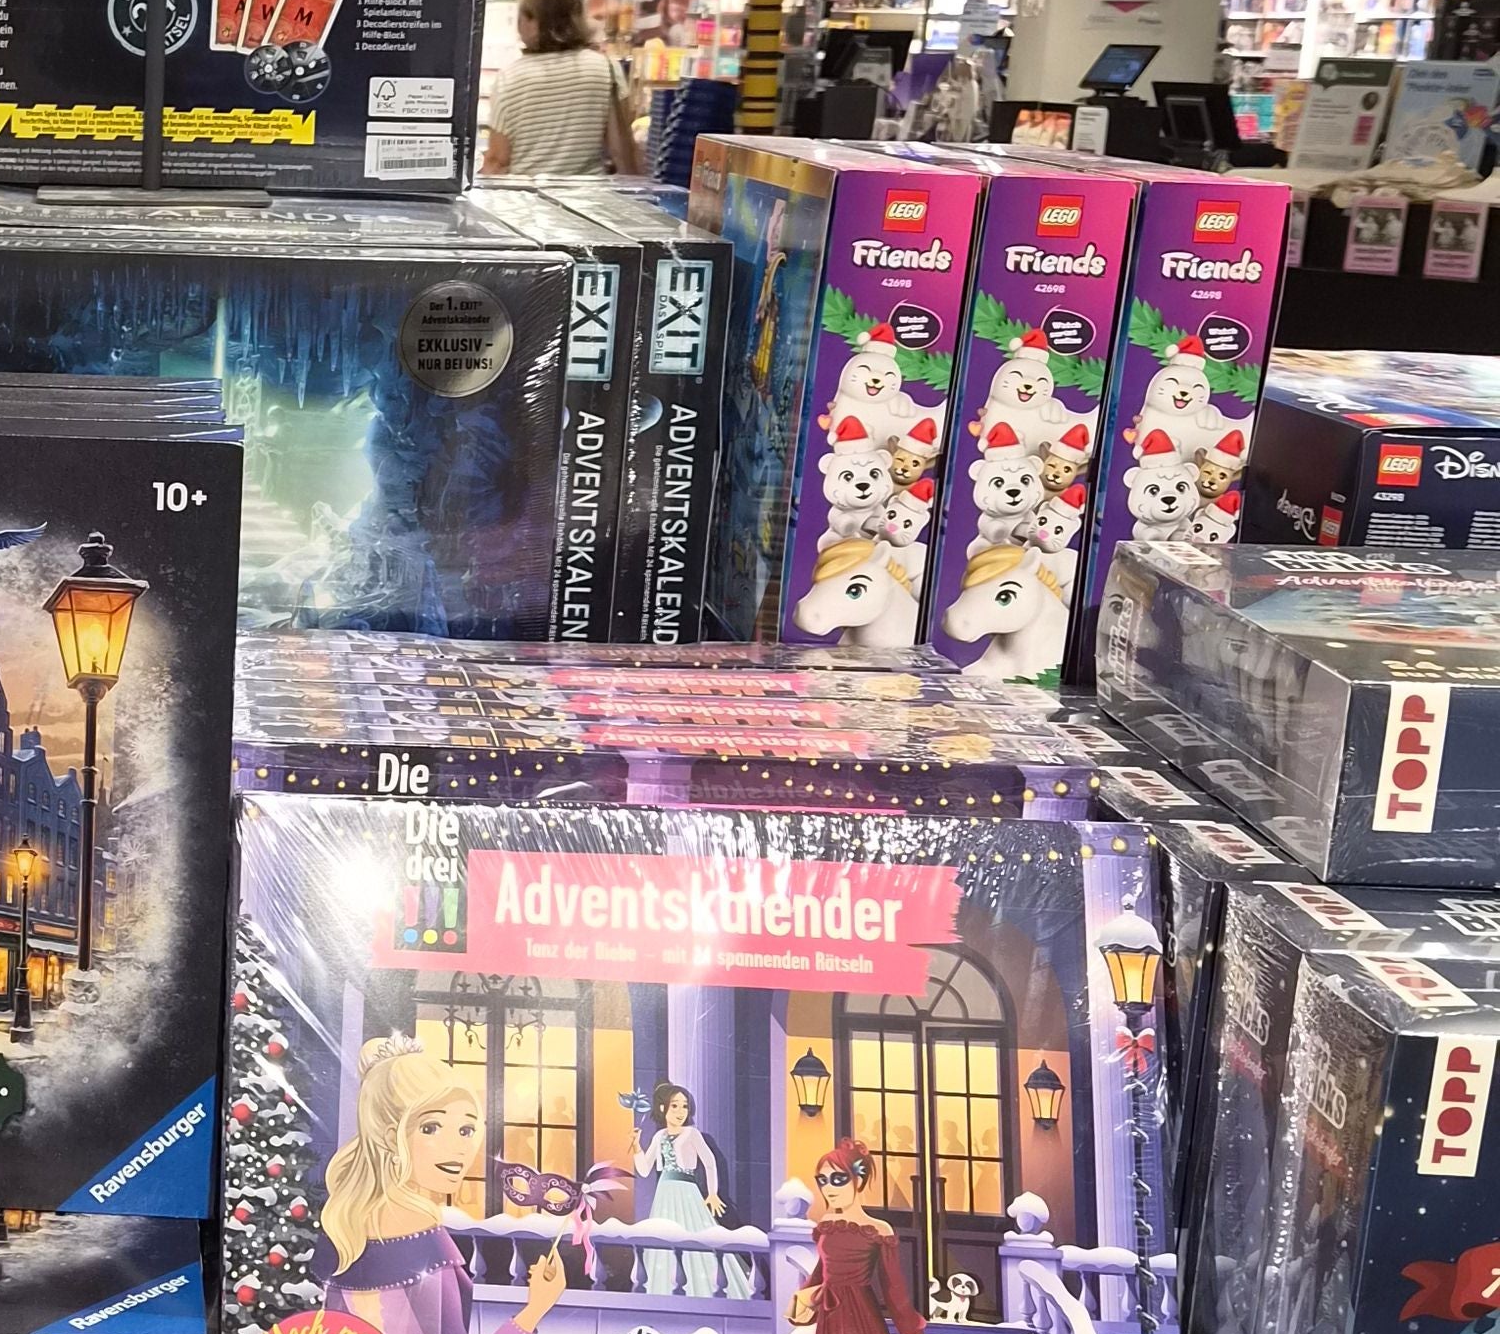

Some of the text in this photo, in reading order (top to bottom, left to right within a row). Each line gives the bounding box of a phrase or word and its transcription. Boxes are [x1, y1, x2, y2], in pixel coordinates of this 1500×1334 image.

[886, 202, 926, 221] LEGO
[1039, 207, 1080, 227] LEGO
[1196, 213, 1236, 233] LEGO
[851, 239, 953, 271] Friends
[1004, 243, 1106, 278] Friends
[1159, 251, 1263, 283] Friends
[881, 278, 912, 289] 42698
[1034, 283, 1066, 294] 42698
[1190, 289, 1222, 300] 42698
[570, 270, 614, 374] EXIT
[658, 265, 704, 369] EXIT
[417, 338, 482, 352] EXKLUSIV
[417, 356, 493, 370] NUR BEI UNS!
[1381, 456, 1421, 473] LEGO
[152, 481, 208, 512] 10+
[1387, 694, 1435, 819] TOPP
[376, 753, 430, 796] Die
[405, 805, 460, 847] Die
[406, 846, 459, 883] drei
[495, 861, 903, 943] Adventskalender
[716, 949, 874, 974] spannenden Rätseln
[1430, 1045, 1482, 1164] TOPP
[88, 1099, 208, 1205] Ravensburger
[67, 1272, 190, 1331] Ravensburger
